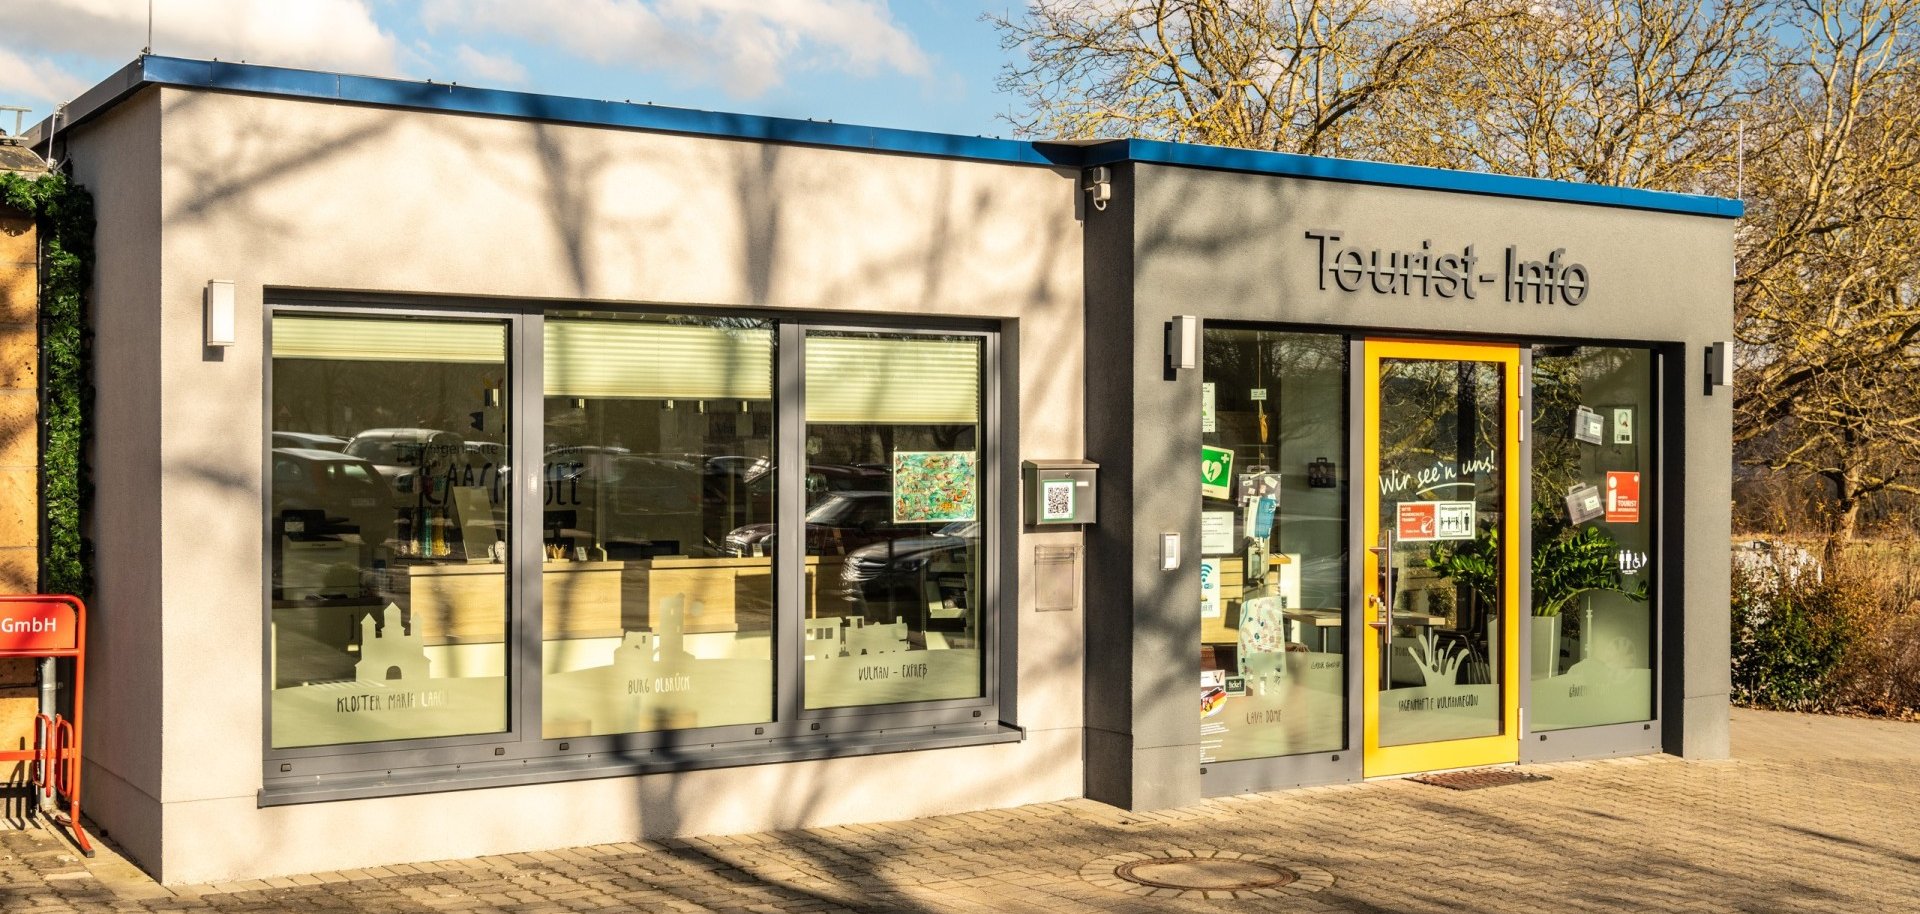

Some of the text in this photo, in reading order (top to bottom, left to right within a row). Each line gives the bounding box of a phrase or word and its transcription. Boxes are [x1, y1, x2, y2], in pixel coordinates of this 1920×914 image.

[1379, 469, 1411, 495] Wir
[1462, 449, 1495, 475] uns!
[1, 617, 57, 633] GmbH
[627, 678, 650, 695] BURG
[336, 694, 381, 713] KLOSTER
[421, 689, 448, 708] LAAC
